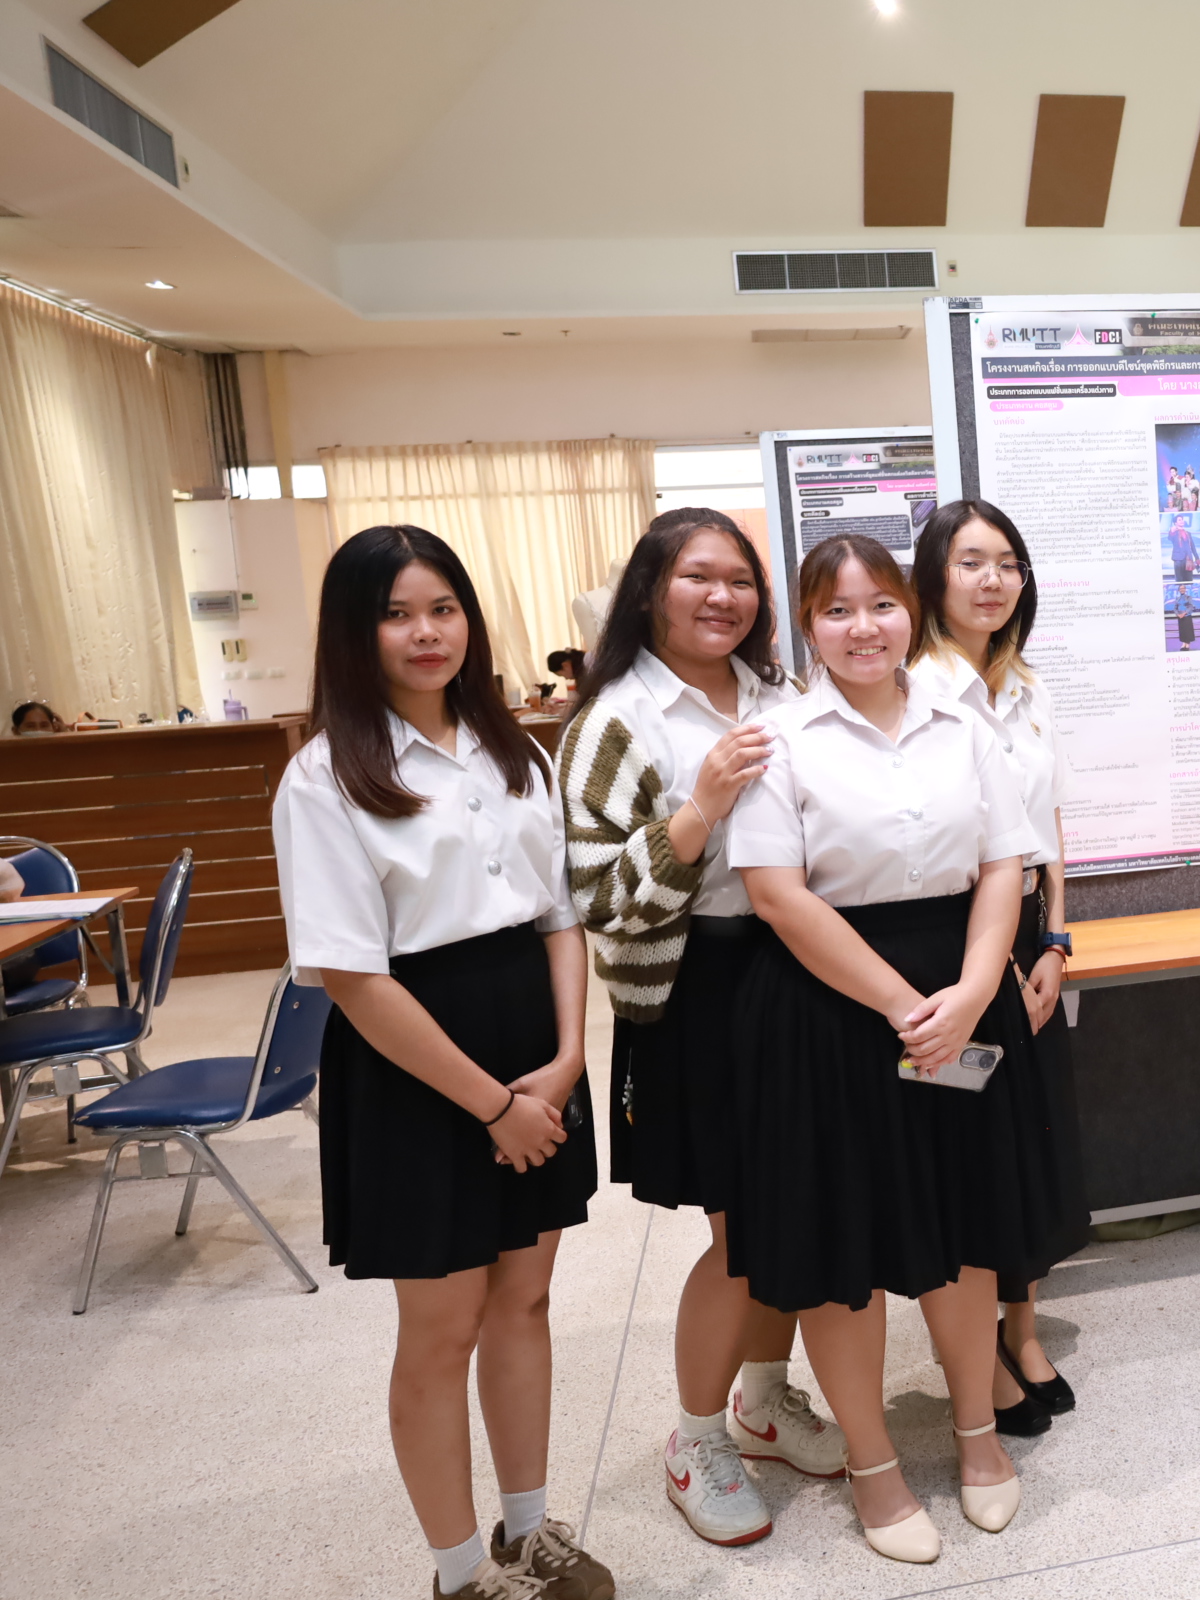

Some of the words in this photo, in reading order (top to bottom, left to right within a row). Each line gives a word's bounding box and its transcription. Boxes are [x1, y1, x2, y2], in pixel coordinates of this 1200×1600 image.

[1002, 328, 1061, 342] RMUTT
[1095, 330, 1120, 343] FDCI
[986, 358, 1065, 373] โครงงานสหกิจเรื่อง
[1158, 378, 1176, 390] โดย
[993, 417, 1025, 426] บทคัดย่อ
[807, 454, 842, 464] RMUTT
